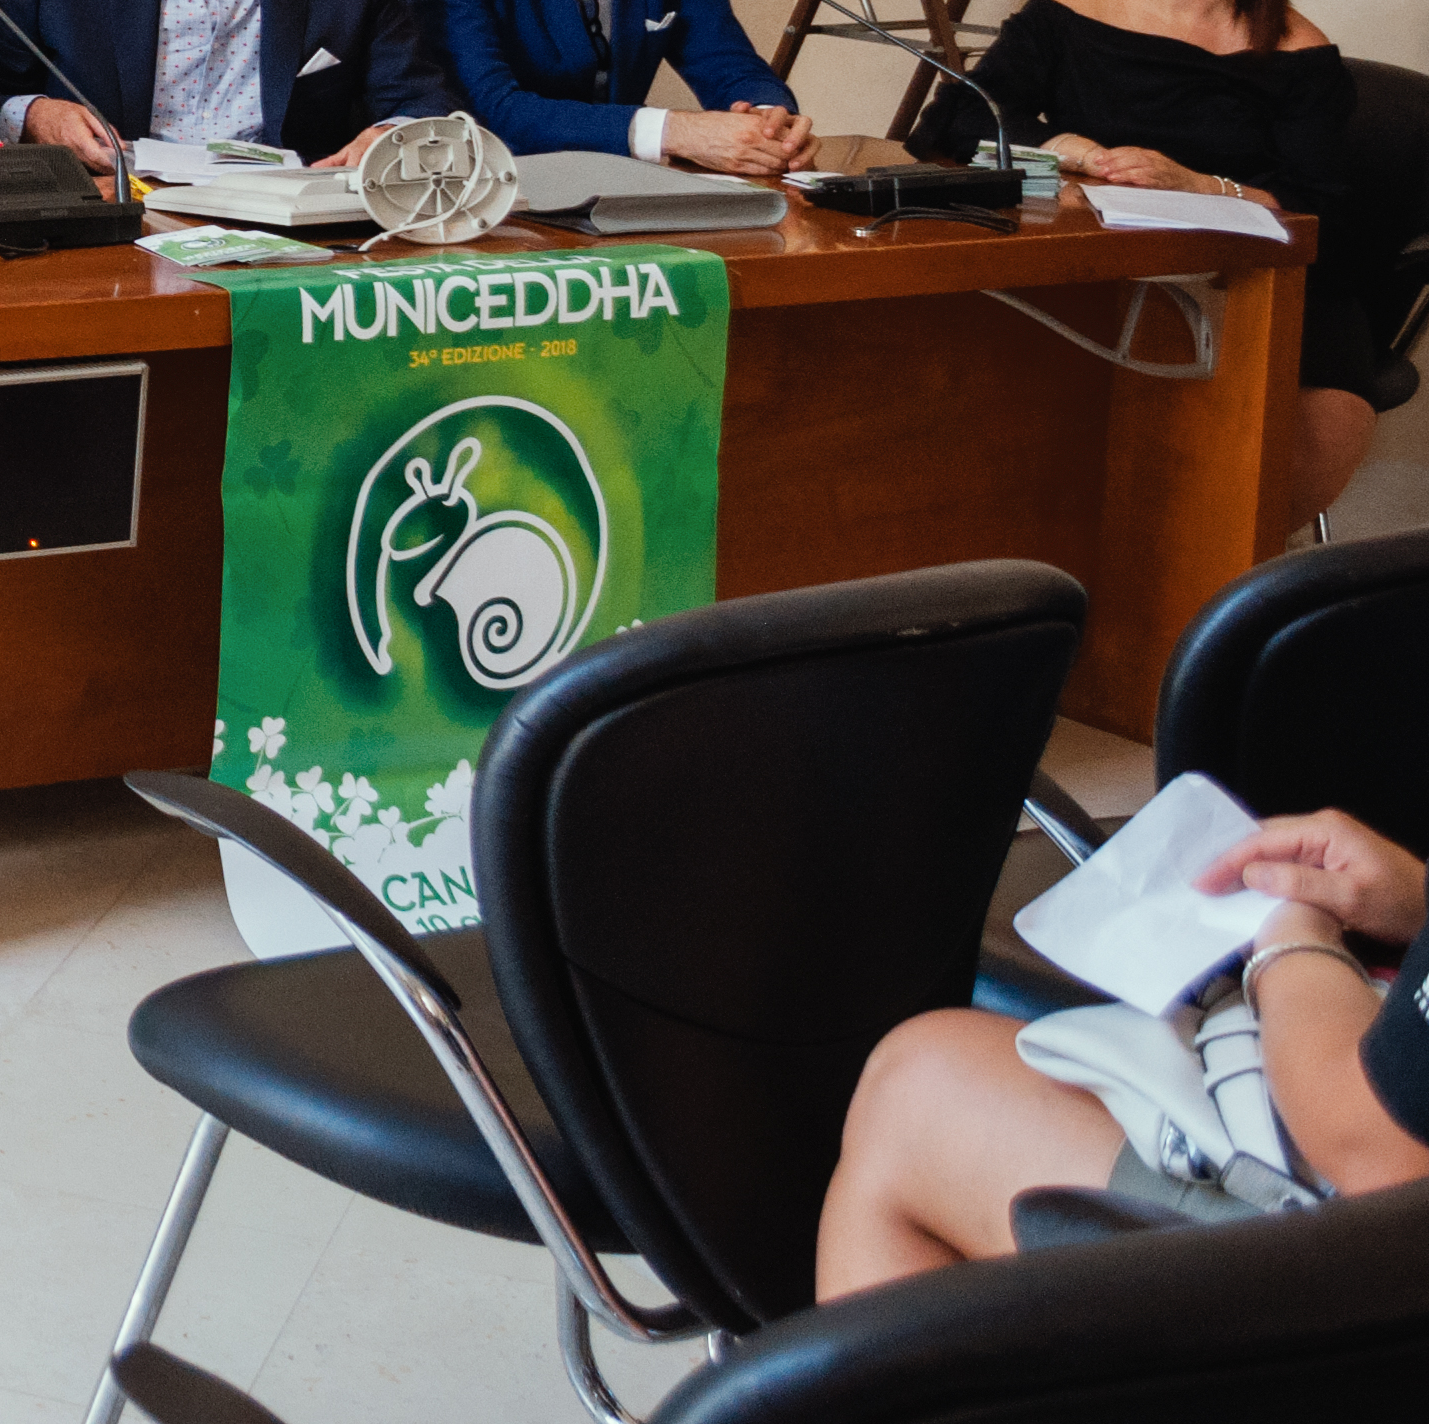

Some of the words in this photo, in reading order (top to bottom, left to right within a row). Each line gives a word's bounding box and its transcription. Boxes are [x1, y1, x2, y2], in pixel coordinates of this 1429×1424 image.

[332, 262, 475, 280] FESTA
[461, 254, 612, 273] DELLA
[299, 263, 680, 344] MUNICEDDHA
[441, 341, 526, 366] EDIZIONE
[540, 338, 578, 358] 2018
[382, 865, 478, 912] CAN
